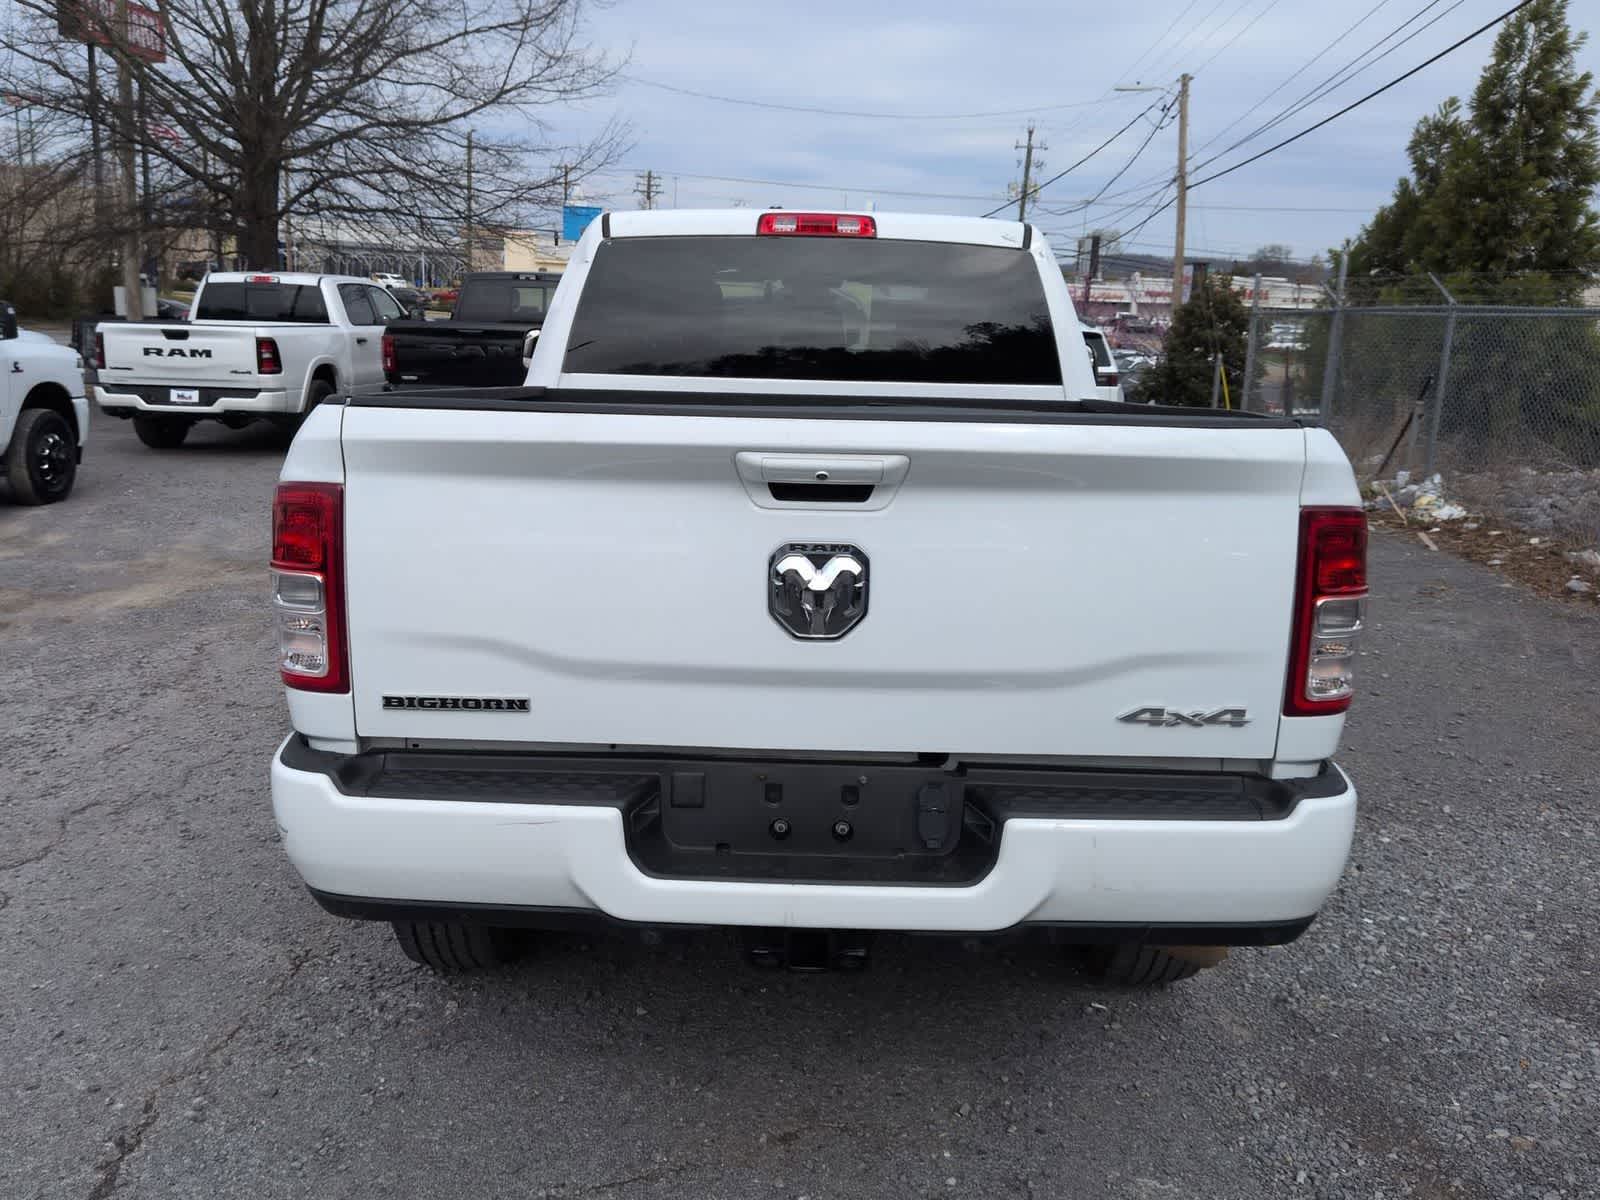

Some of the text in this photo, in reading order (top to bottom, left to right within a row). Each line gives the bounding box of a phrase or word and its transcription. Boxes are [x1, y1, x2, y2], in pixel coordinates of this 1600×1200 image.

[143, 347, 212, 358] RAM
[788, 543, 851, 552] RAM
[382, 695, 530, 712] BIGHORN
